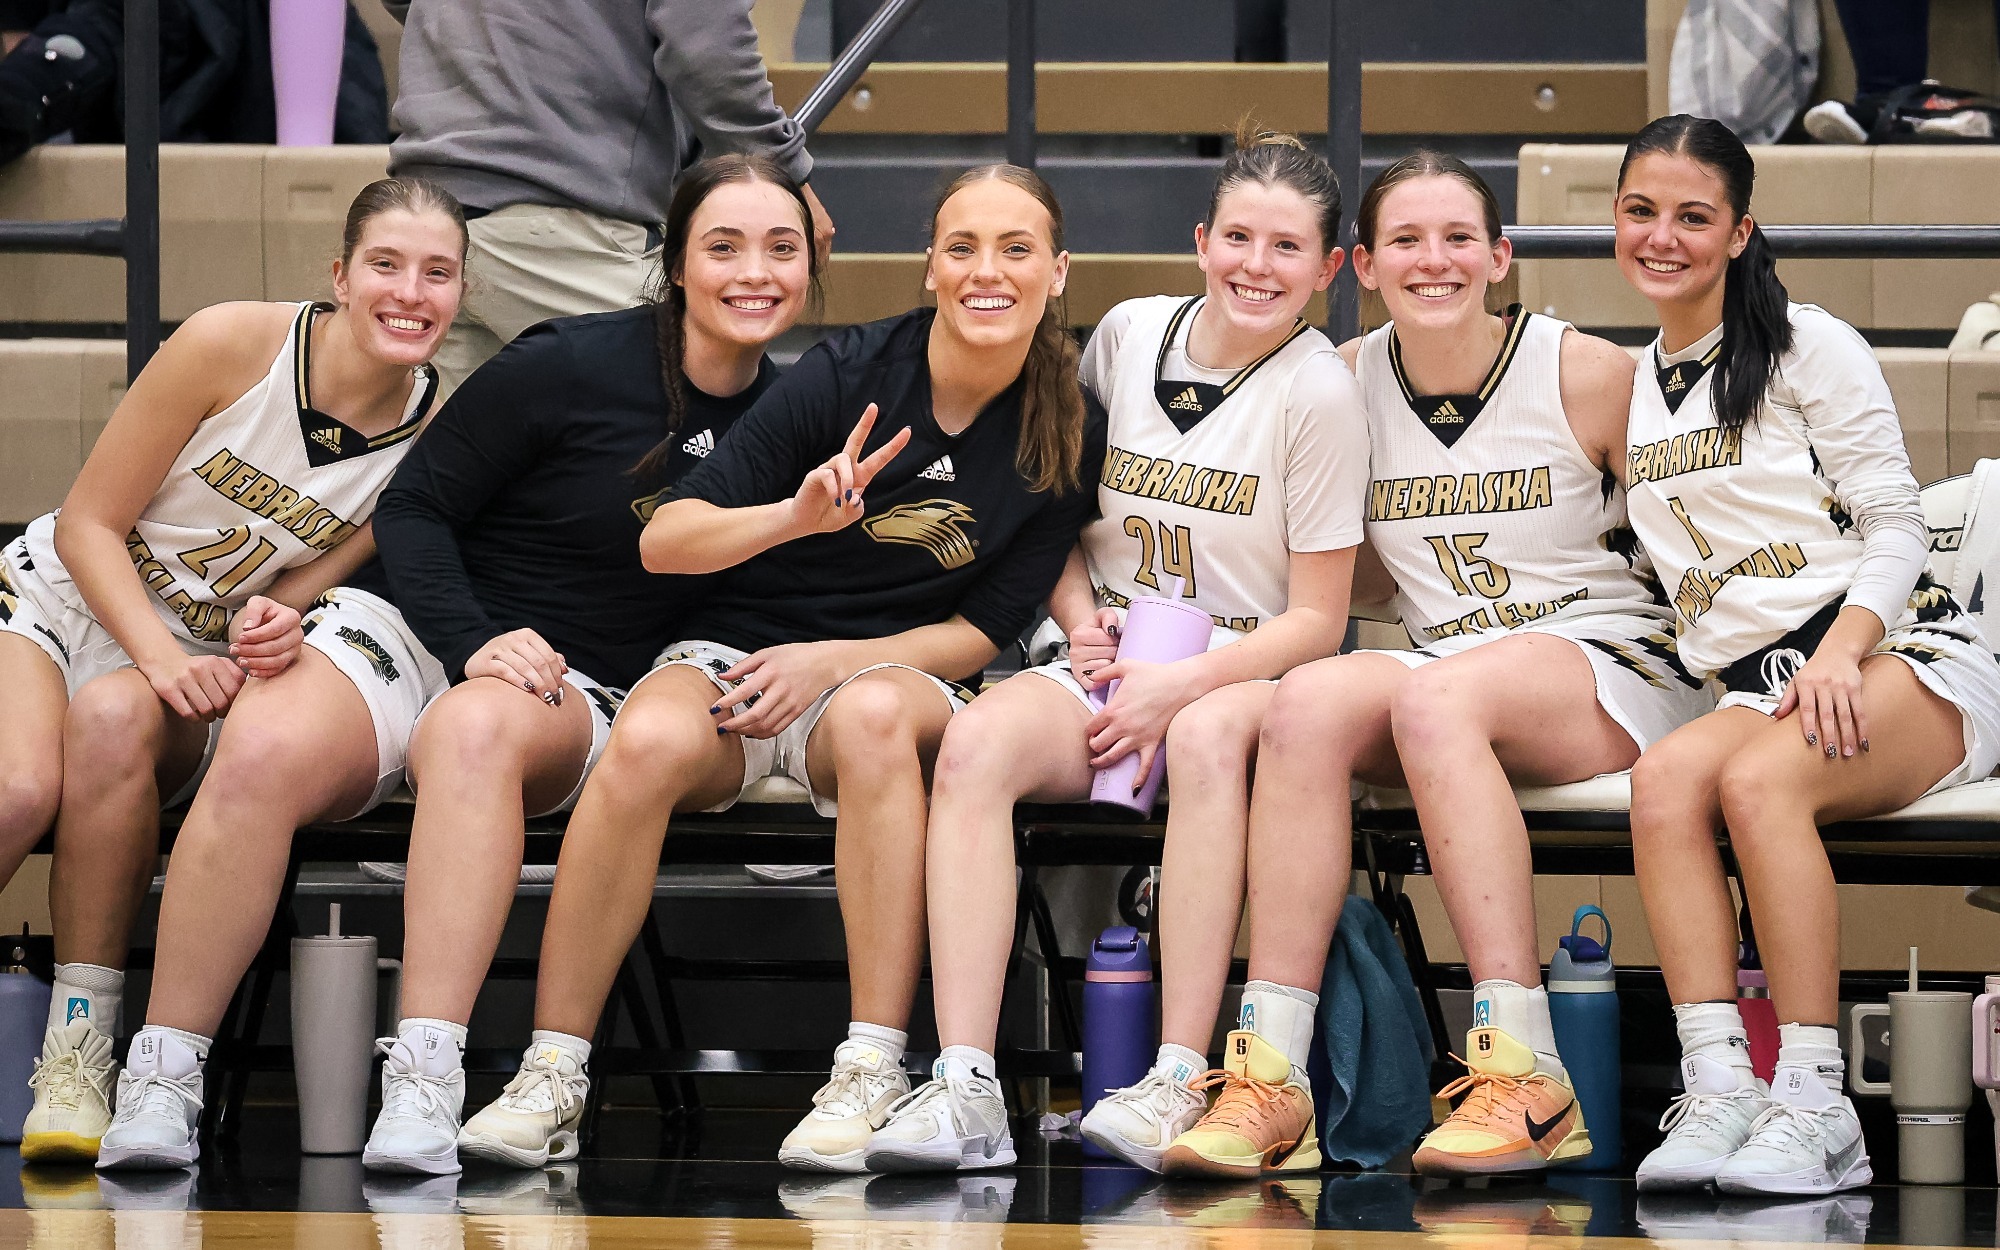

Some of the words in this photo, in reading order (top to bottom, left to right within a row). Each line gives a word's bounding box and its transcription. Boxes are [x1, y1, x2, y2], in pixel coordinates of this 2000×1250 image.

[1169, 400, 1203, 412] adidas
[1430, 414, 1465, 424] adidas
[310, 431, 342, 454] adidas
[191, 447, 359, 550] NEBRASK
[1369, 466, 1552, 522] NEBRASKA
[1123, 515, 1197, 599] 24
[1667, 496, 1713, 561] 1
[176, 525, 279, 598] 21
[1423, 532, 1511, 599] 15
